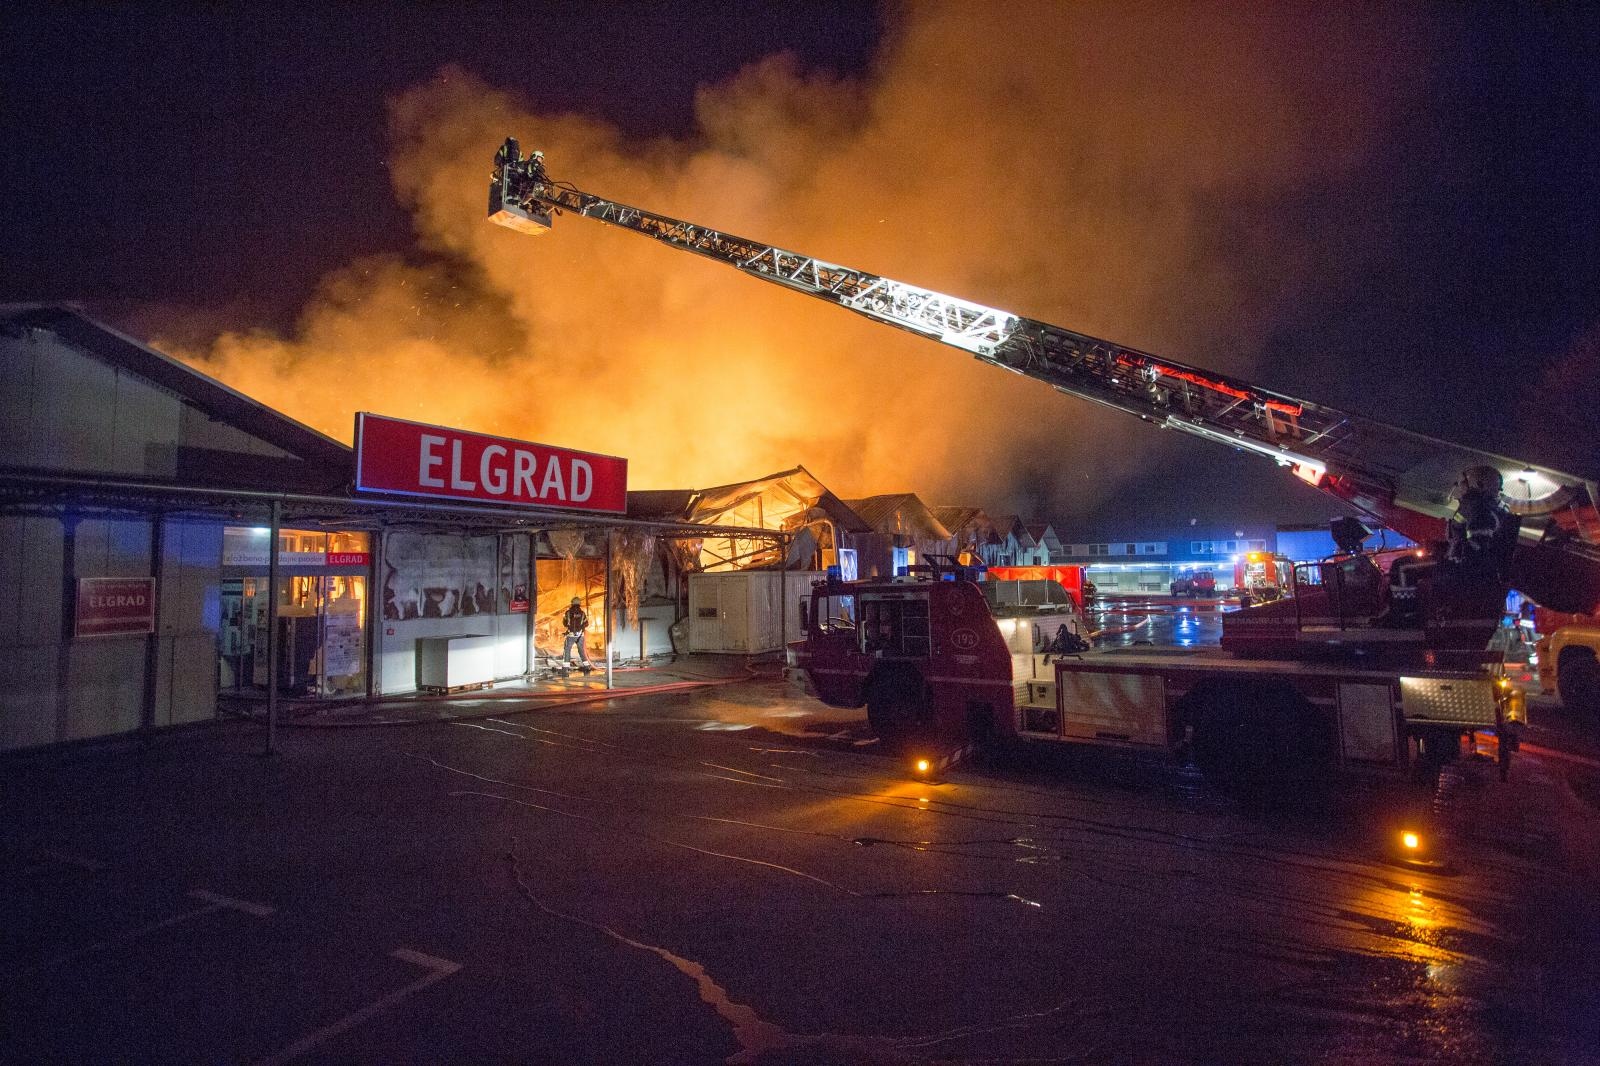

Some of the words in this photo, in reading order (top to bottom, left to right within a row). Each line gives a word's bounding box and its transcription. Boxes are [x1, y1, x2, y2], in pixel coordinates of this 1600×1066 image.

[419, 434, 593, 502] ELGRAD
[329, 554, 363, 564] ELGRAD
[89, 594, 146, 608] ELGRAD
